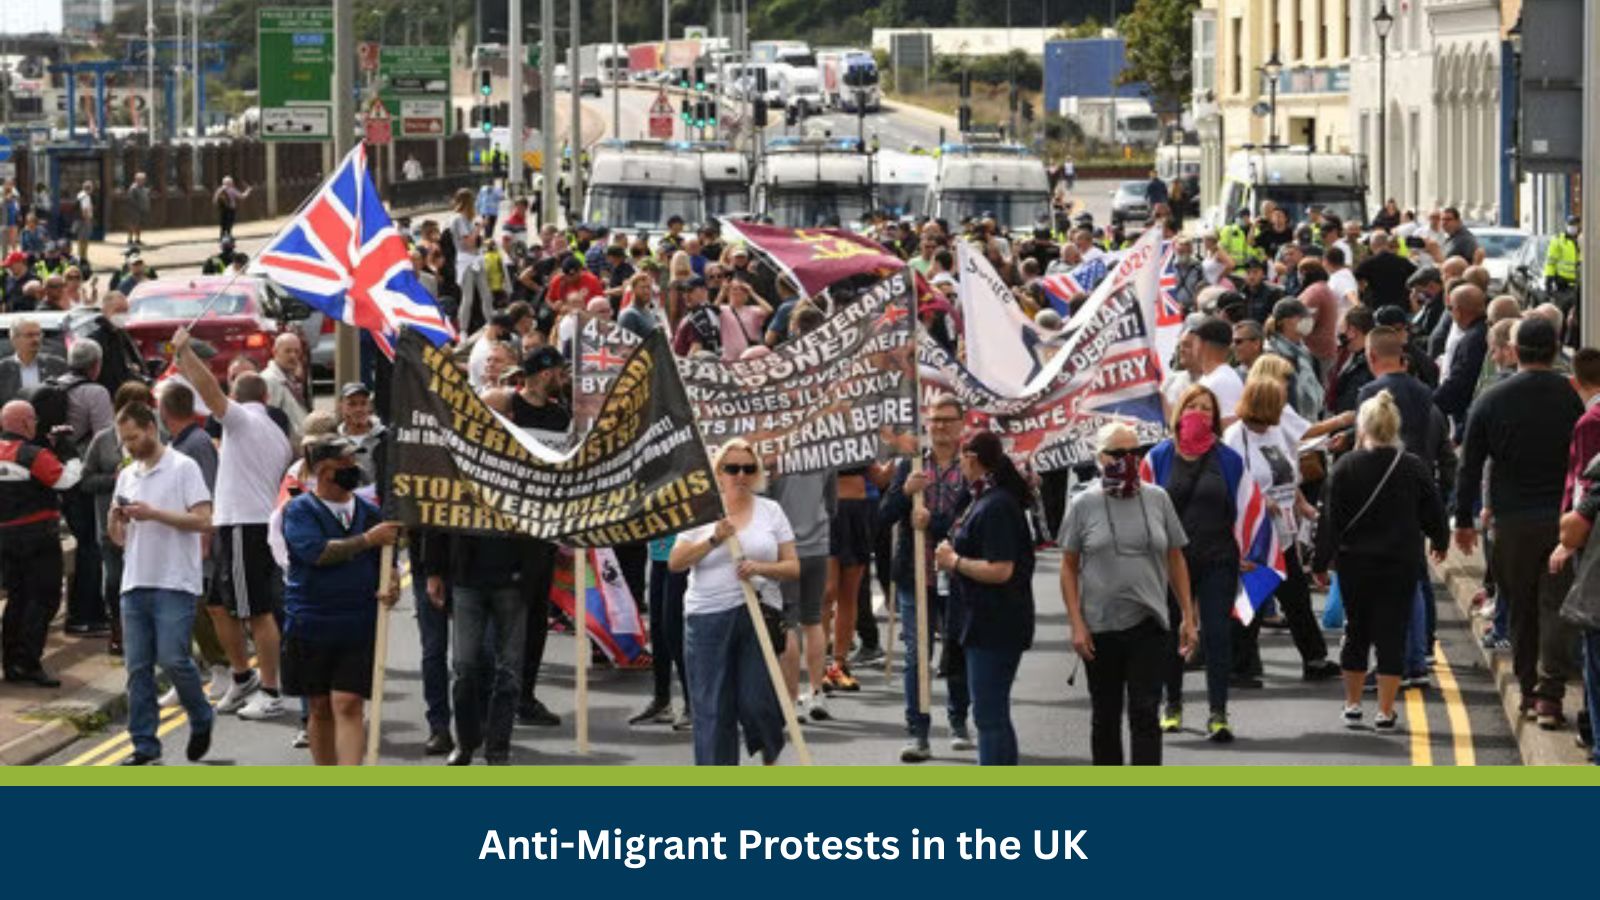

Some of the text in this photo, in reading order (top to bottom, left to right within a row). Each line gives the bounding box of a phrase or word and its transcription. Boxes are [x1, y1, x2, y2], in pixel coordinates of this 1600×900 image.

[786, 273, 907, 356] VETERANS
[581, 376, 609, 394] BY
[706, 390, 792, 417] HOUSES
[733, 421, 757, 434] IN
[571, 501, 697, 547] THREAT!
